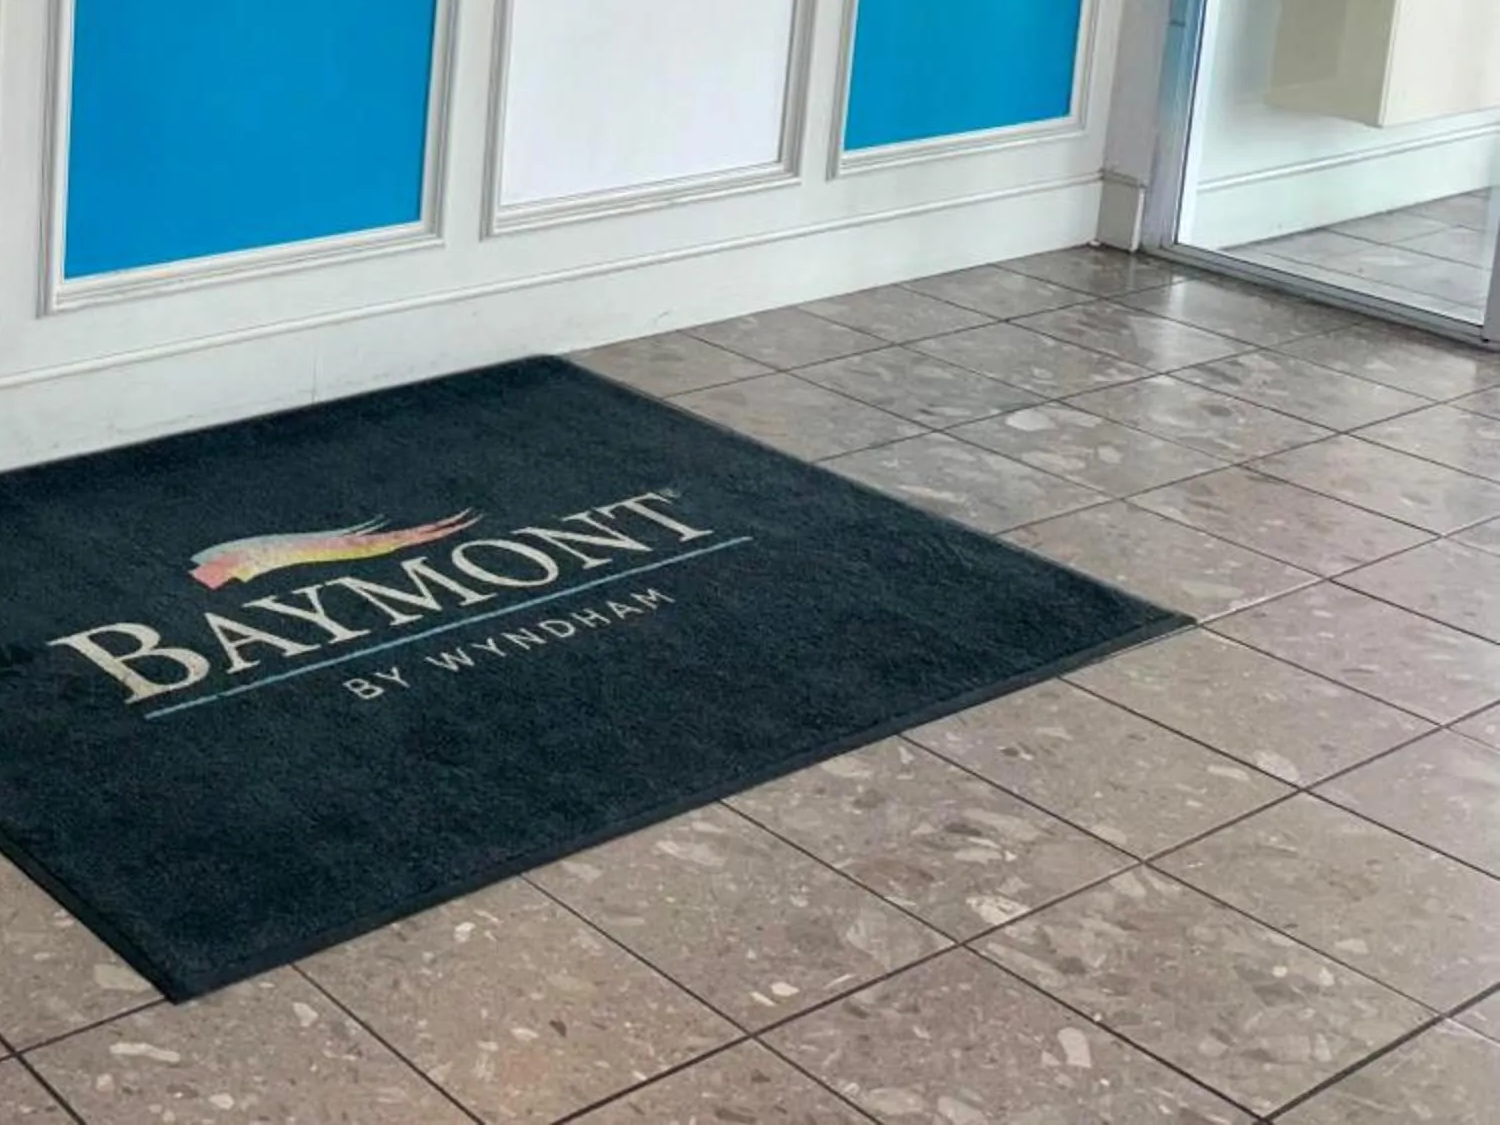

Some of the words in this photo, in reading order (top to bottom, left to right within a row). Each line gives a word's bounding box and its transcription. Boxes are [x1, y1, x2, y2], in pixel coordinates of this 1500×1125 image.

[47, 490, 714, 705] BAYMONT
[342, 667, 413, 701] BY
[424, 585, 677, 675] WYNDHAM
